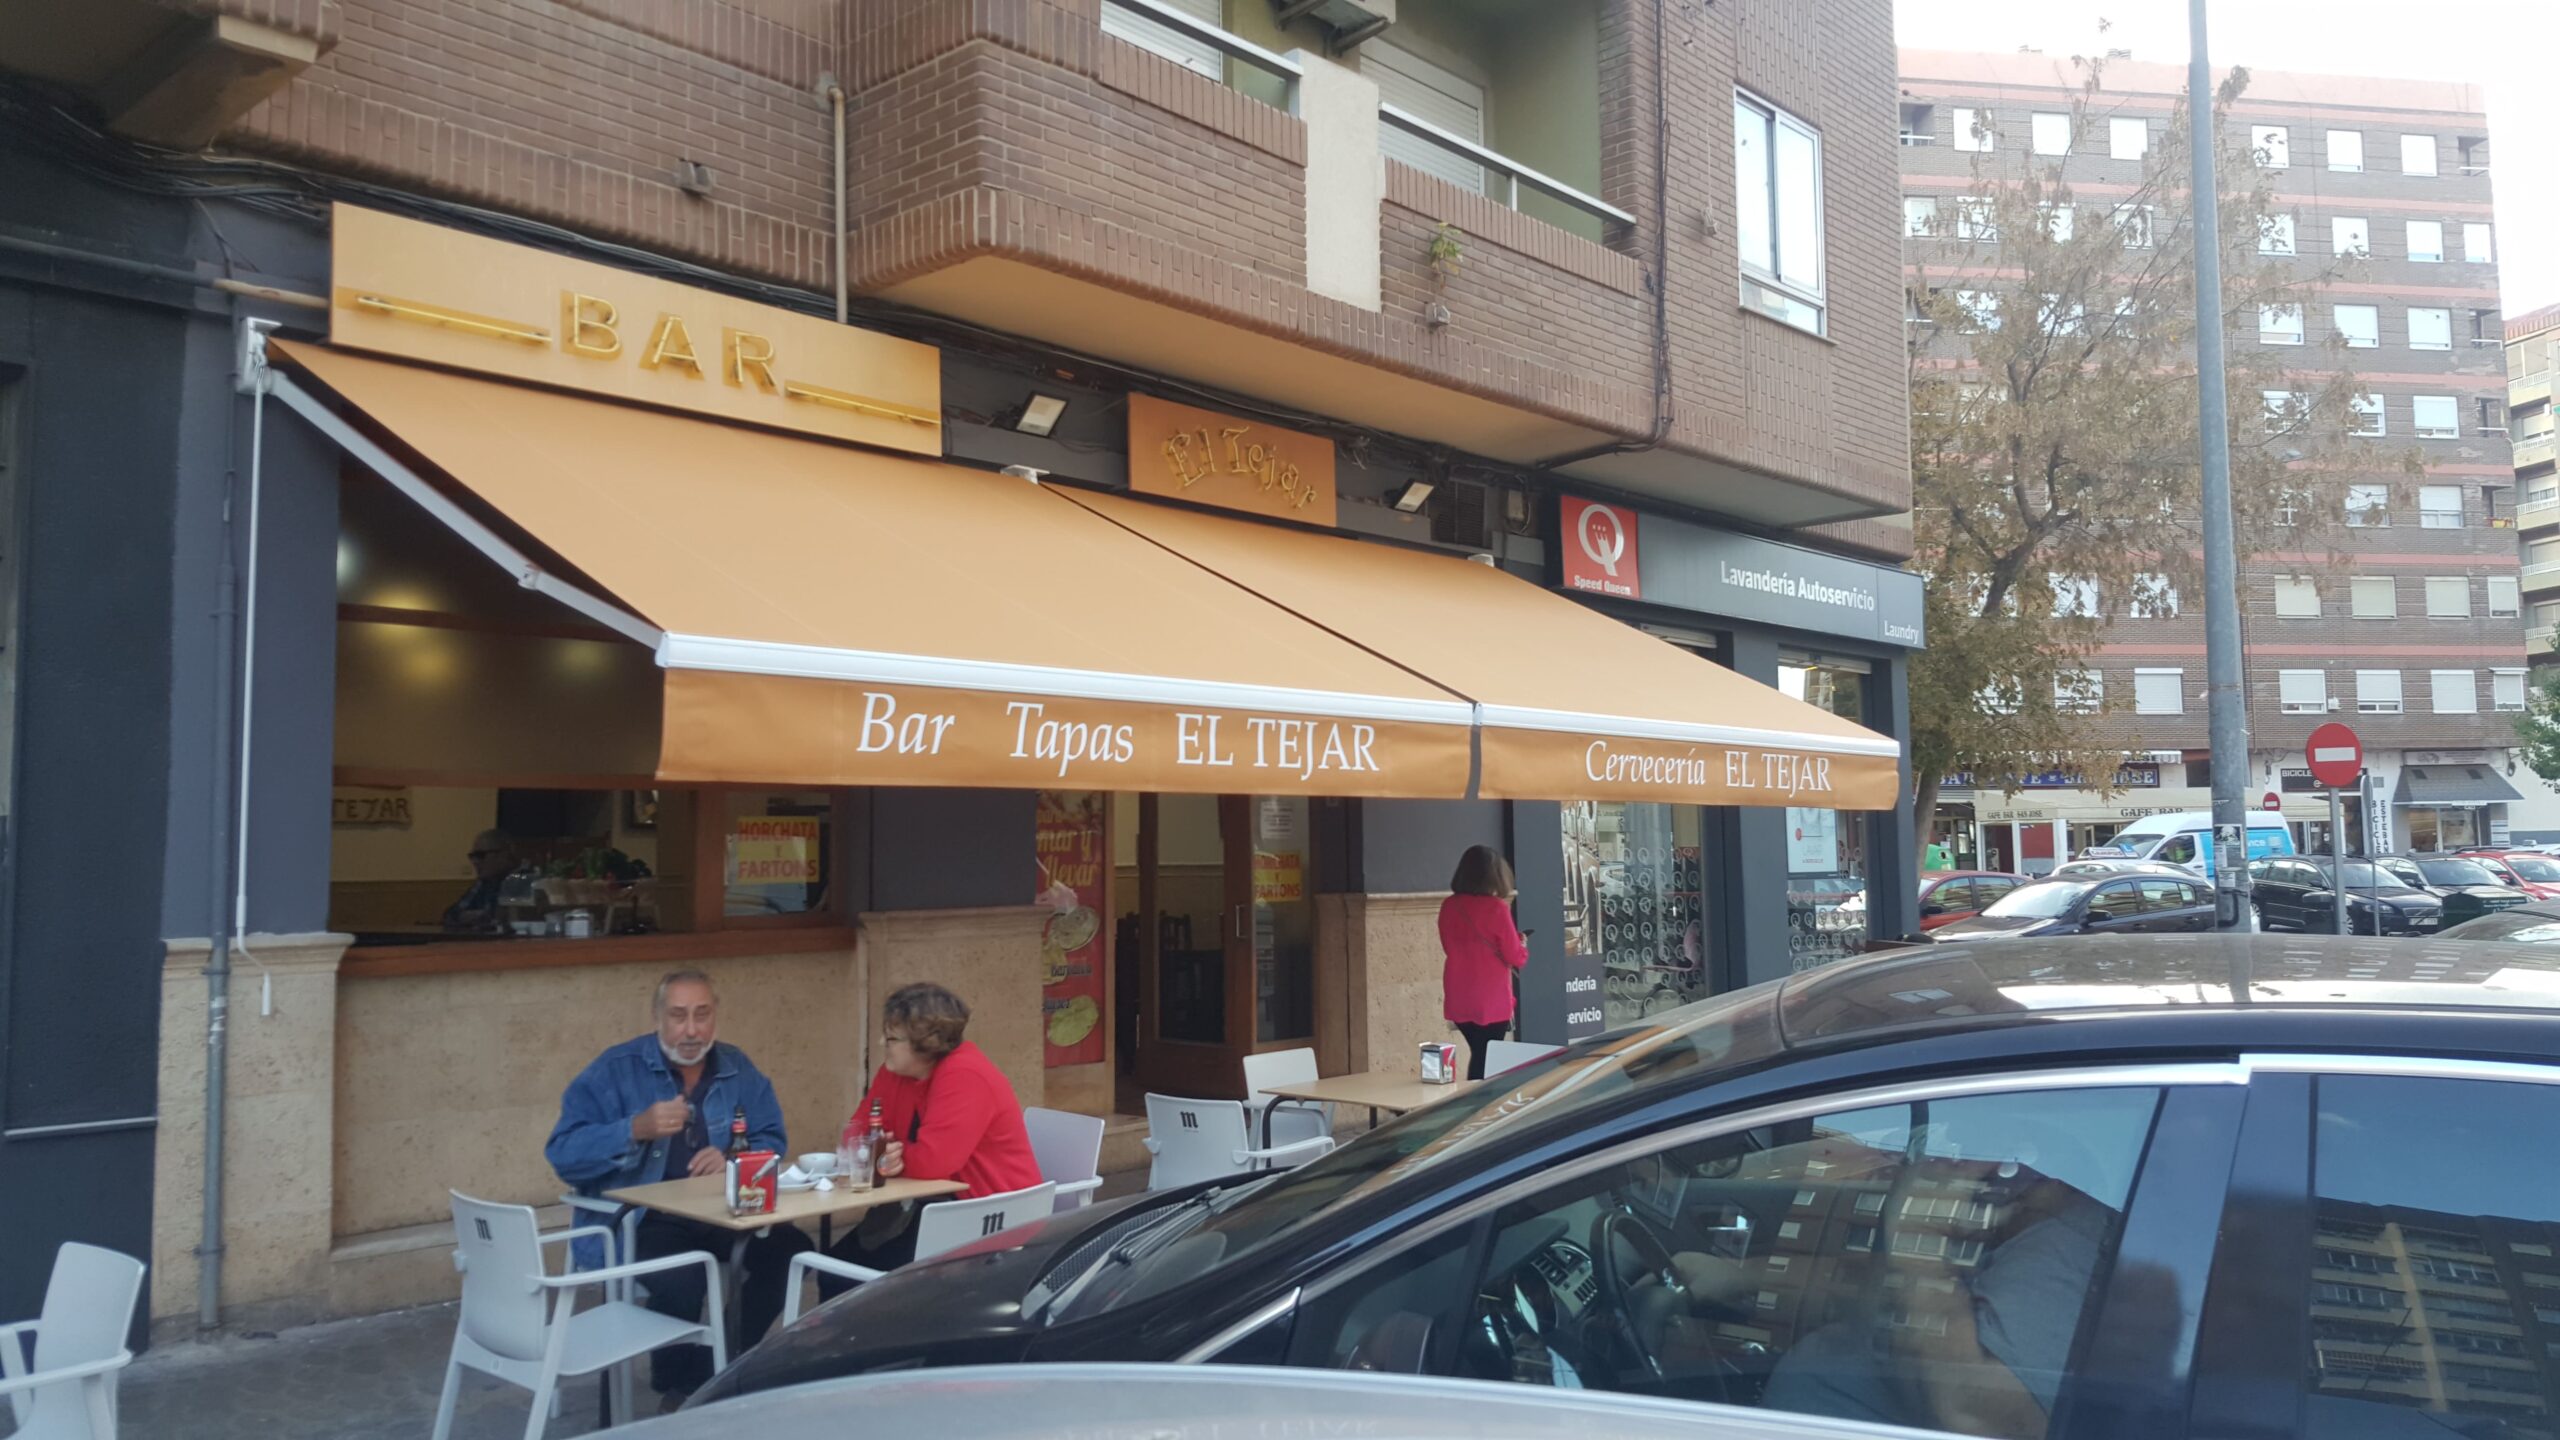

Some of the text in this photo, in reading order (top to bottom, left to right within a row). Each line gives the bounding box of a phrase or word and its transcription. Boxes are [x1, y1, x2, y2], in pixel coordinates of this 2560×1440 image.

[560, 289, 780, 397] BAR
[1164, 426, 1318, 508] El Tejar
[1574, 574, 1632, 596] Speed Queen
[1720, 560, 1875, 612] Lavandería Autoservicio
[1883, 620, 1920, 645] Laundry
[856, 691, 1381, 781] Bar Tapas EL TEJAR
[1585, 740, 1832, 798] Cervecería EL TEJAR
[737, 821, 818, 840] HORCHATA
[2380, 800, 2390, 855] ESTEBAN
[738, 860, 818, 879] FARTONS
